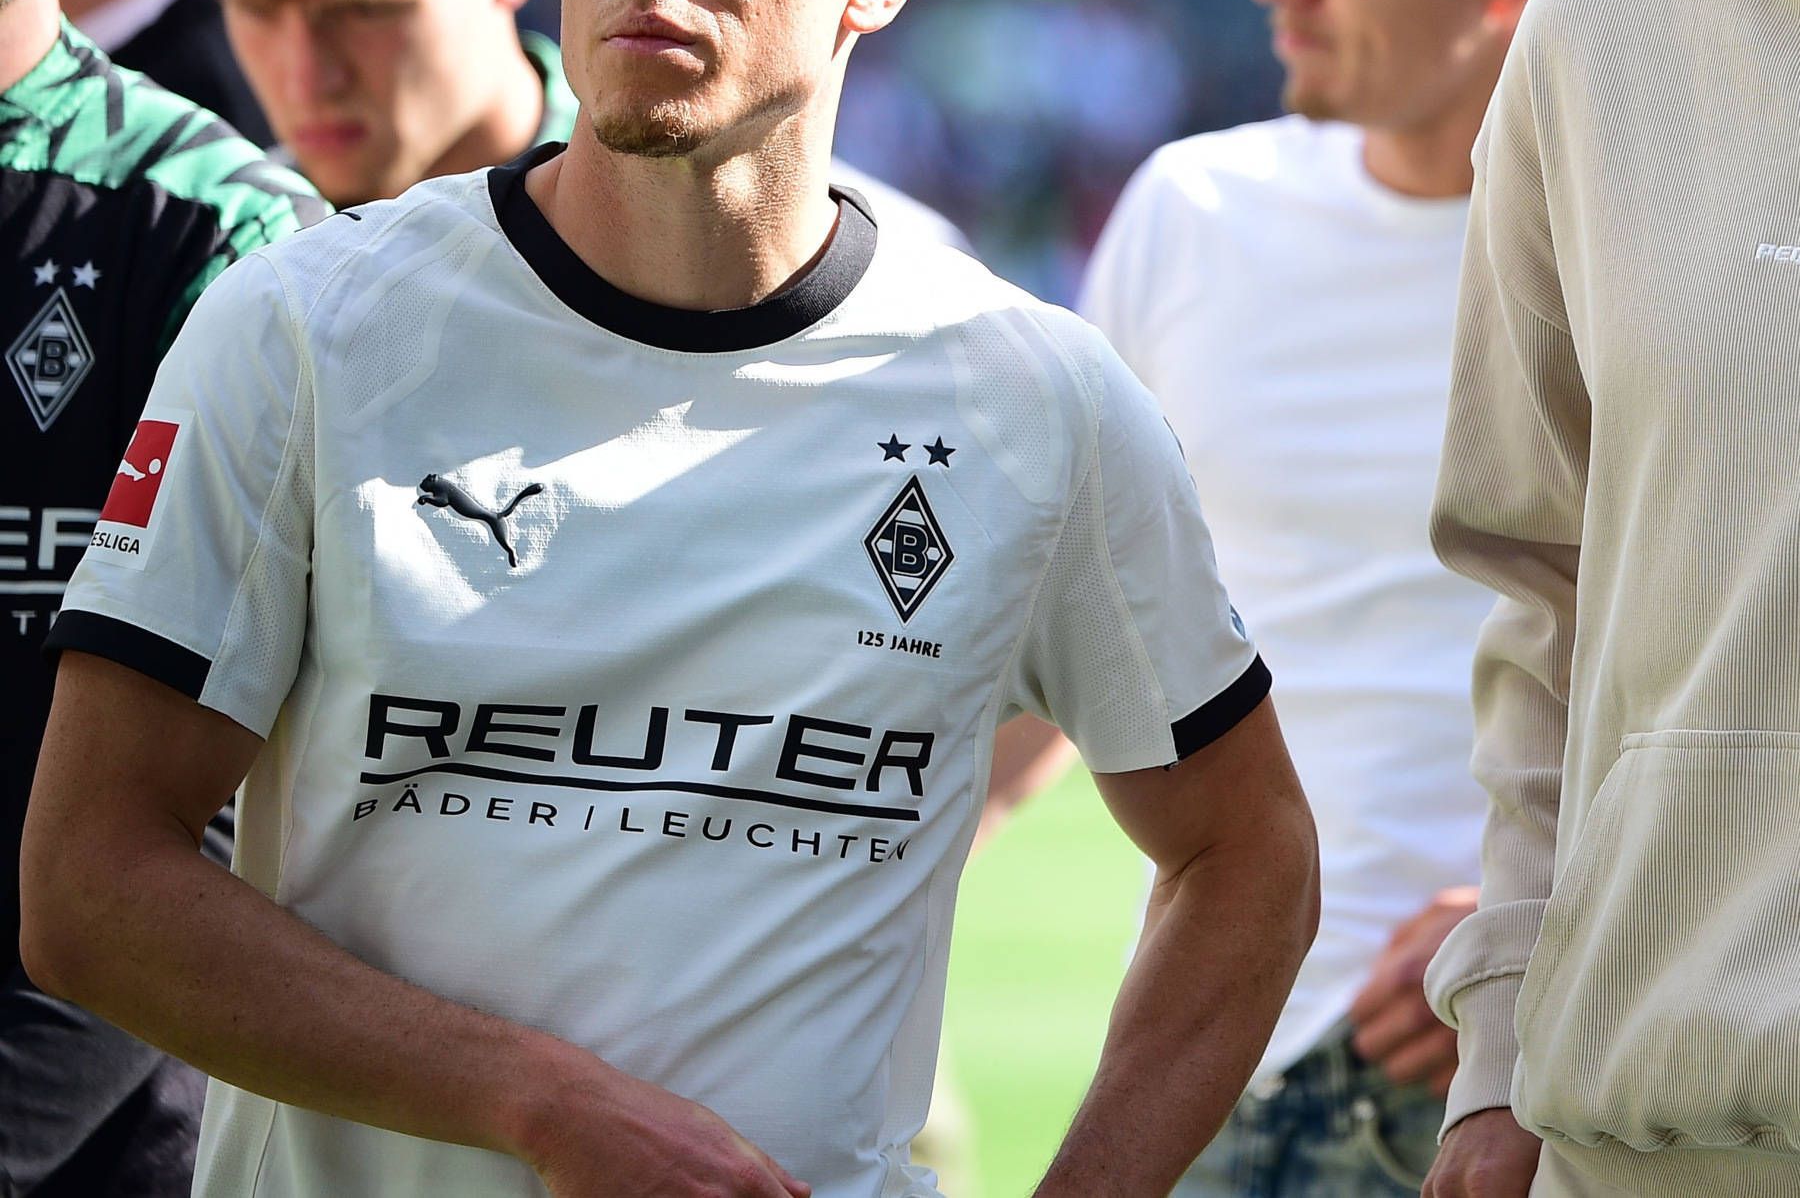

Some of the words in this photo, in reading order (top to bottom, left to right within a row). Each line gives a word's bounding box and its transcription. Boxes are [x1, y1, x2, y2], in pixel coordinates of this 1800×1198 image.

[91, 531, 140, 555] ESLIGA
[892, 522, 928, 577] B
[857, 630, 885, 647] 125
[889, 635, 943, 658] JAHRE
[364, 693, 936, 796] REUTER
[353, 783, 558, 827] BÄDER
[620, 807, 911, 863] LEUCHTEN
